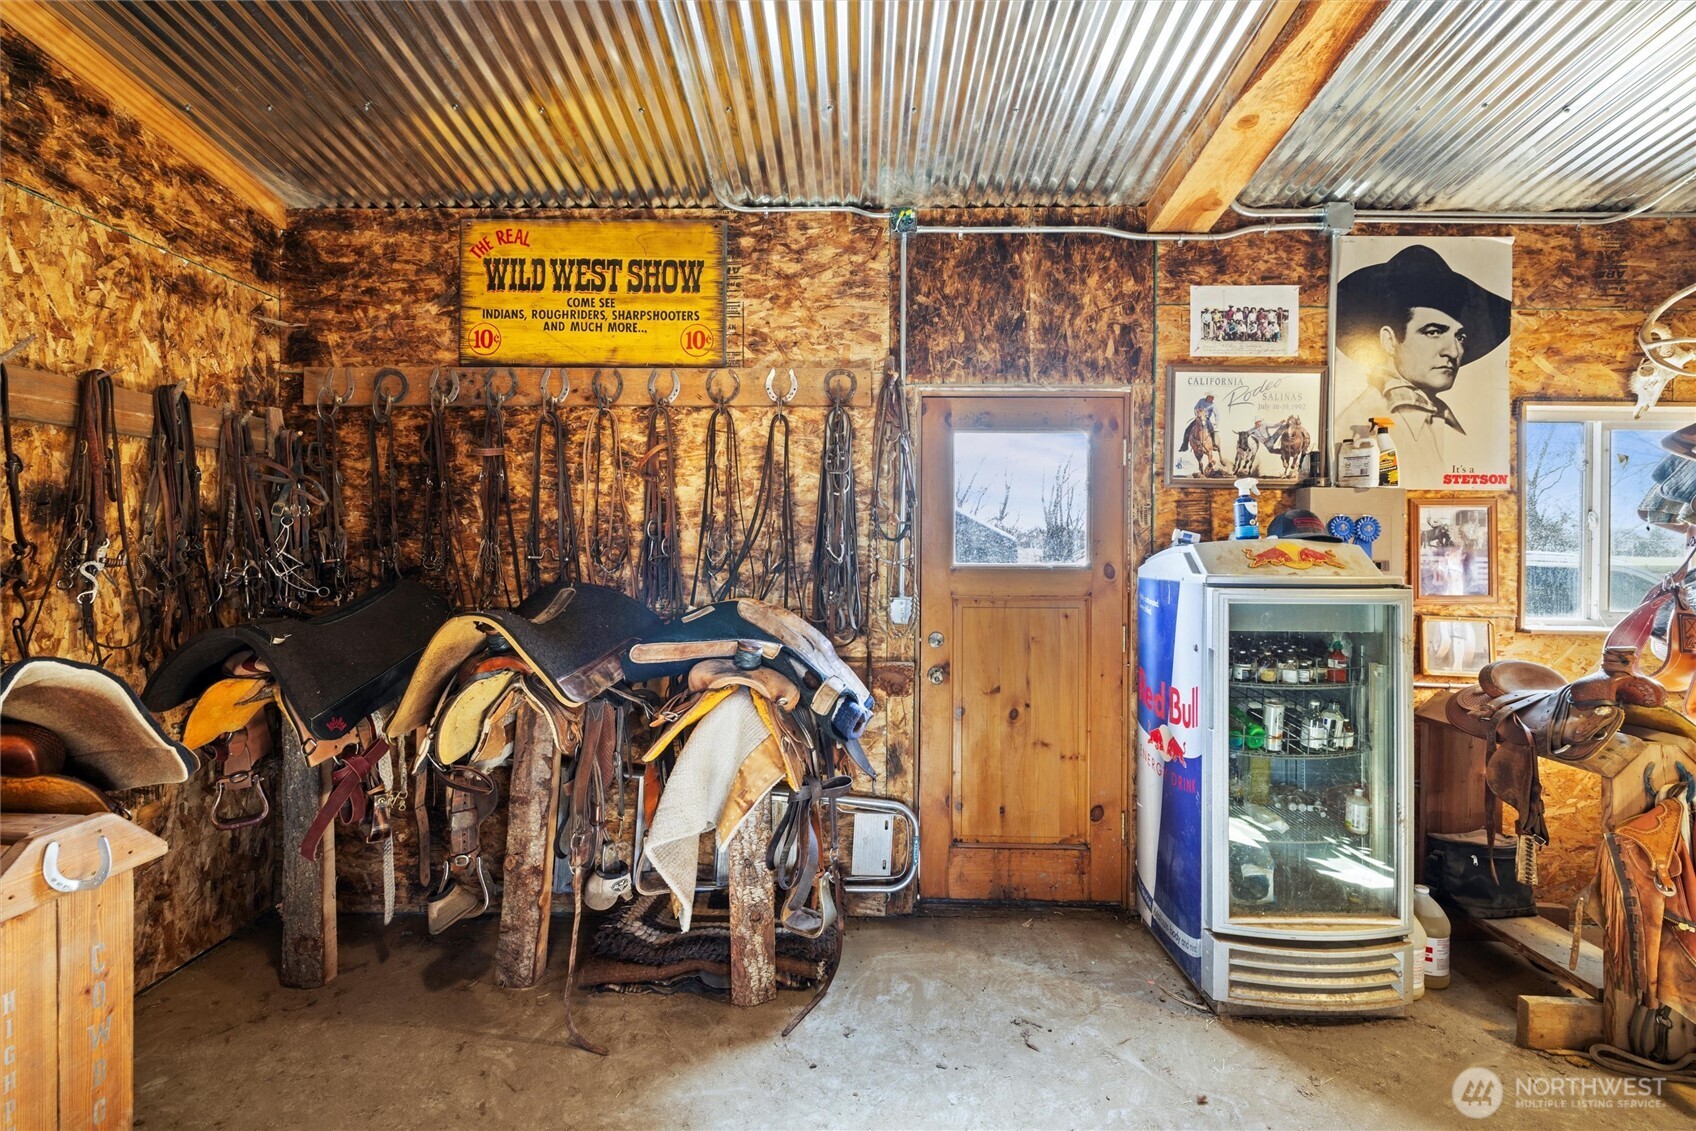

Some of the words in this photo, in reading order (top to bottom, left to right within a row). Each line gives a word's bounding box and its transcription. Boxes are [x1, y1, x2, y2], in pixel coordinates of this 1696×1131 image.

[469, 236, 494, 259] THE
[495, 228, 530, 247] REAL
[483, 257, 546, 293] WILD
[550, 258, 622, 294] WEST
[627, 259, 705, 294] SHOW
[566, 297, 595, 308] COME
[598, 297, 616, 308] SEE
[482, 308, 527, 321] INDIANS,
[531, 309, 608, 321] ROUGHRIDERS,
[612, 310, 700, 321] SHARPSHOOTERS
[543, 321, 565, 332] AND
[570, 321, 603, 332] MUCH
[607, 323, 648, 333] MORE...
[1187, 377, 1244, 386] CALIFORNIA
[1222, 377, 1289, 413] Rodeo
[1262, 393, 1303, 401] SALINAS
[1258, 403, 1271, 411] July
[1452, 464, 1467, 473] It's
[1443, 474, 1508, 485] STETSON
[1138, 666, 1166, 720] Red
[1169, 686, 1199, 729] Bull
[1139, 744, 1168, 780] ENERGY
[1171, 771, 1197, 794] DRINK
